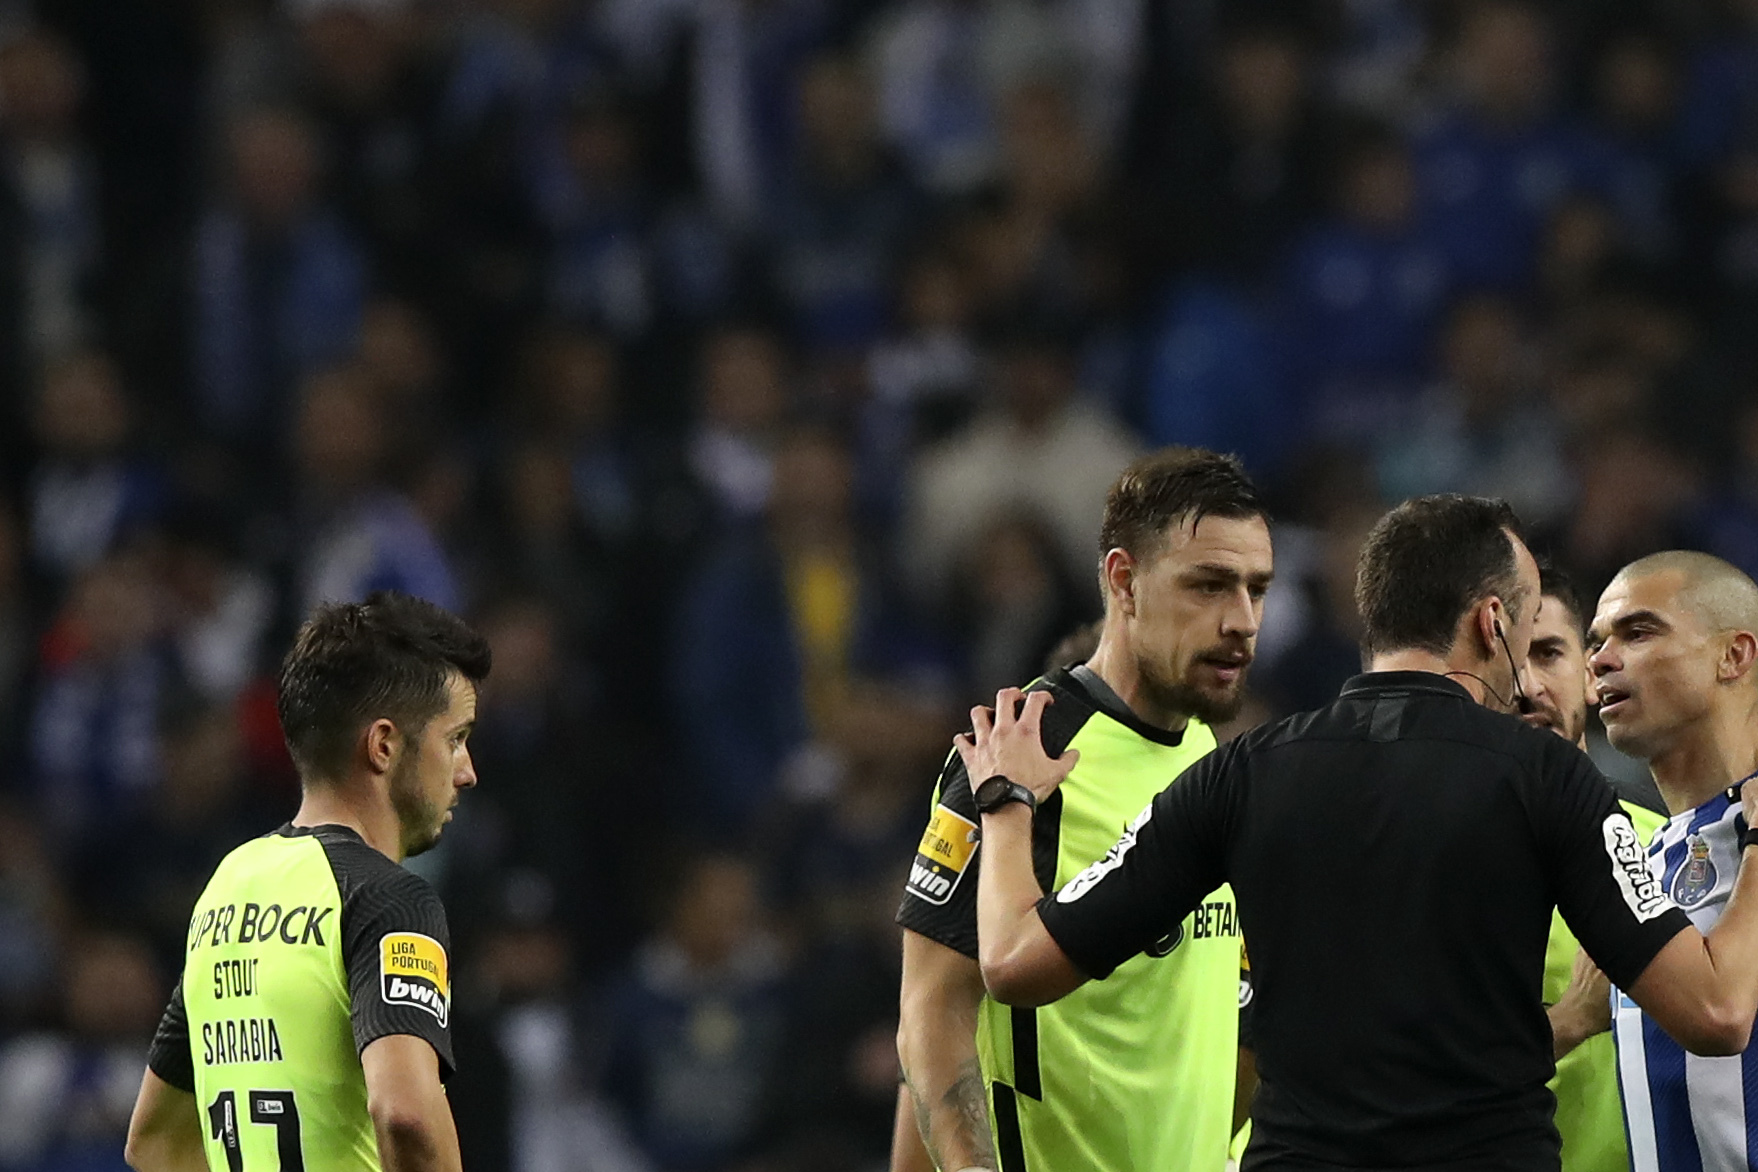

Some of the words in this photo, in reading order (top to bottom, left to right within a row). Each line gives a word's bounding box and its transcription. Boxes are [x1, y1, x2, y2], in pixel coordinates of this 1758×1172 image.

[909, 862, 951, 897] win
[238, 902, 333, 947] BOCK
[1192, 902, 1240, 940] BETA
[391, 943, 416, 956] LIGA
[214, 958, 259, 999] STOUT
[389, 978, 446, 1020] bwin
[202, 1018, 283, 1066] SARABIA
